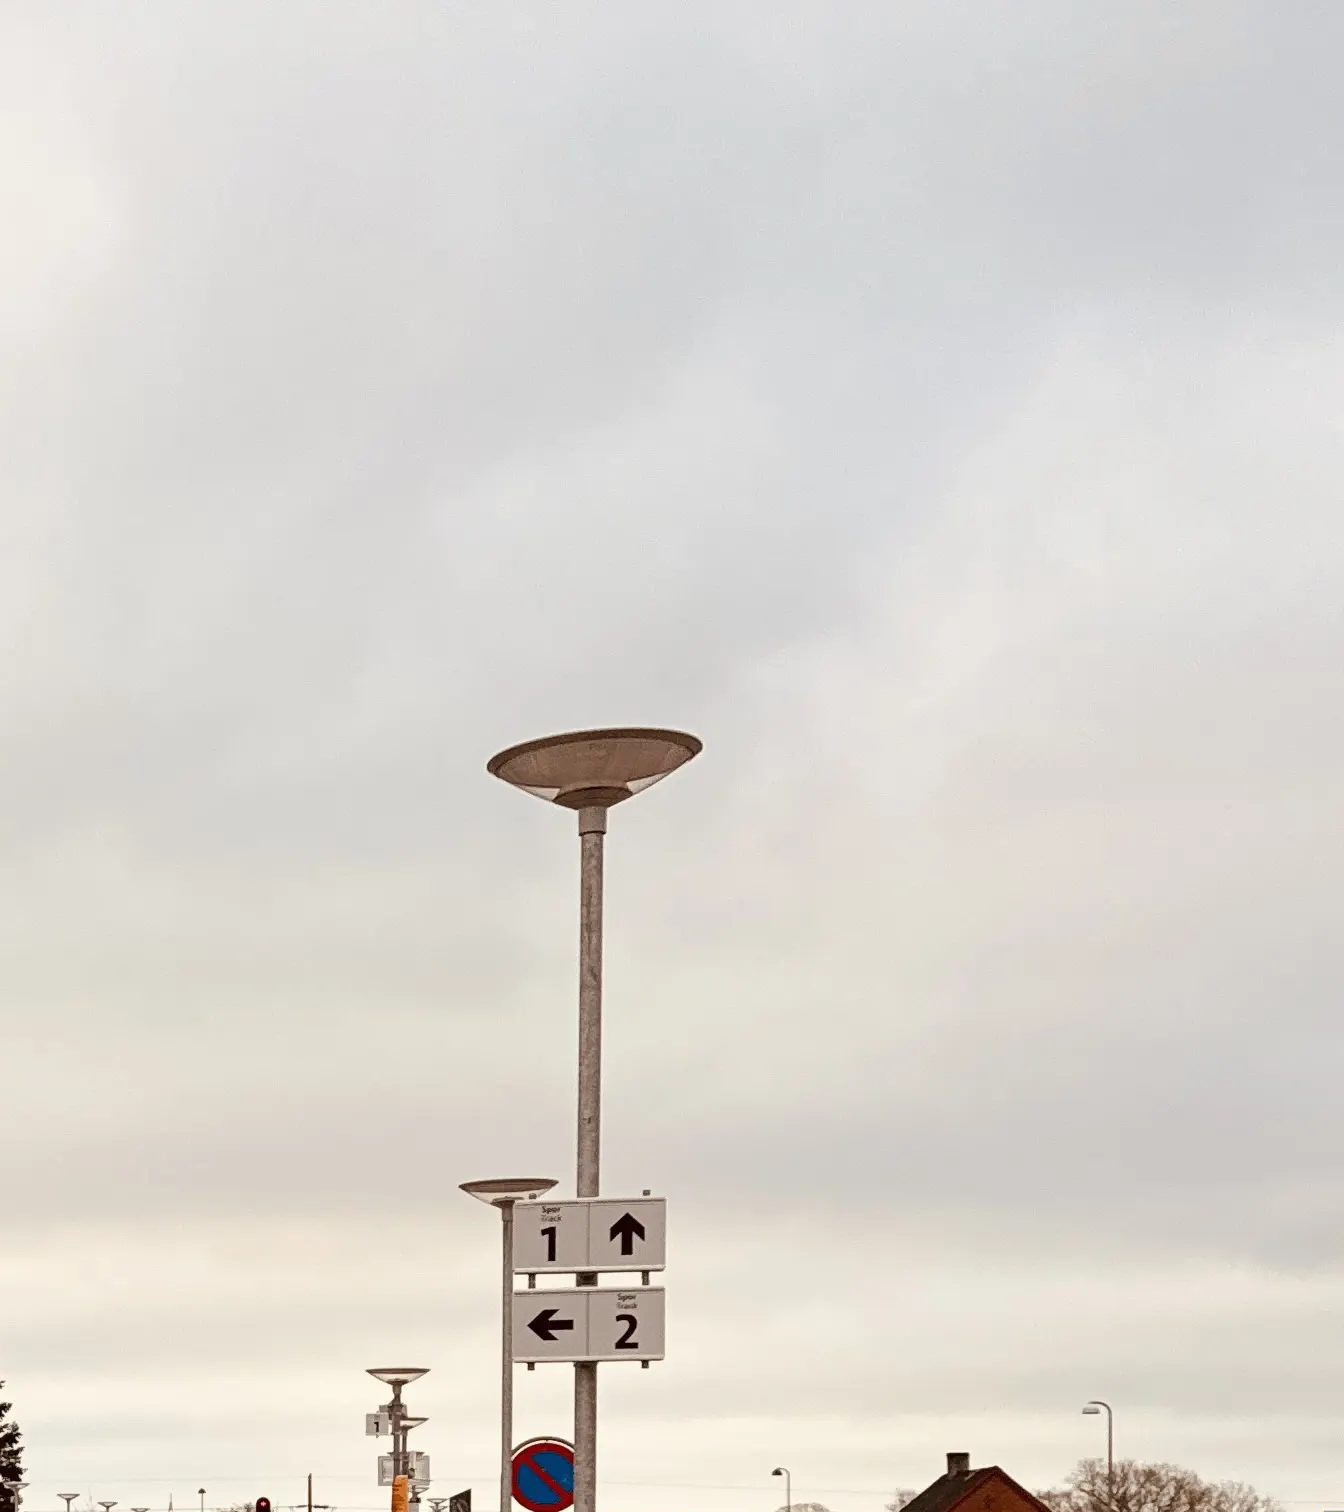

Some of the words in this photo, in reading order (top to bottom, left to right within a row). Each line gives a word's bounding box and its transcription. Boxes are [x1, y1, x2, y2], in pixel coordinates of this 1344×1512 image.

[541, 1226, 556, 1261] 1
[615, 1314, 639, 1349] 2
[373, 1421, 380, 1433] 1
